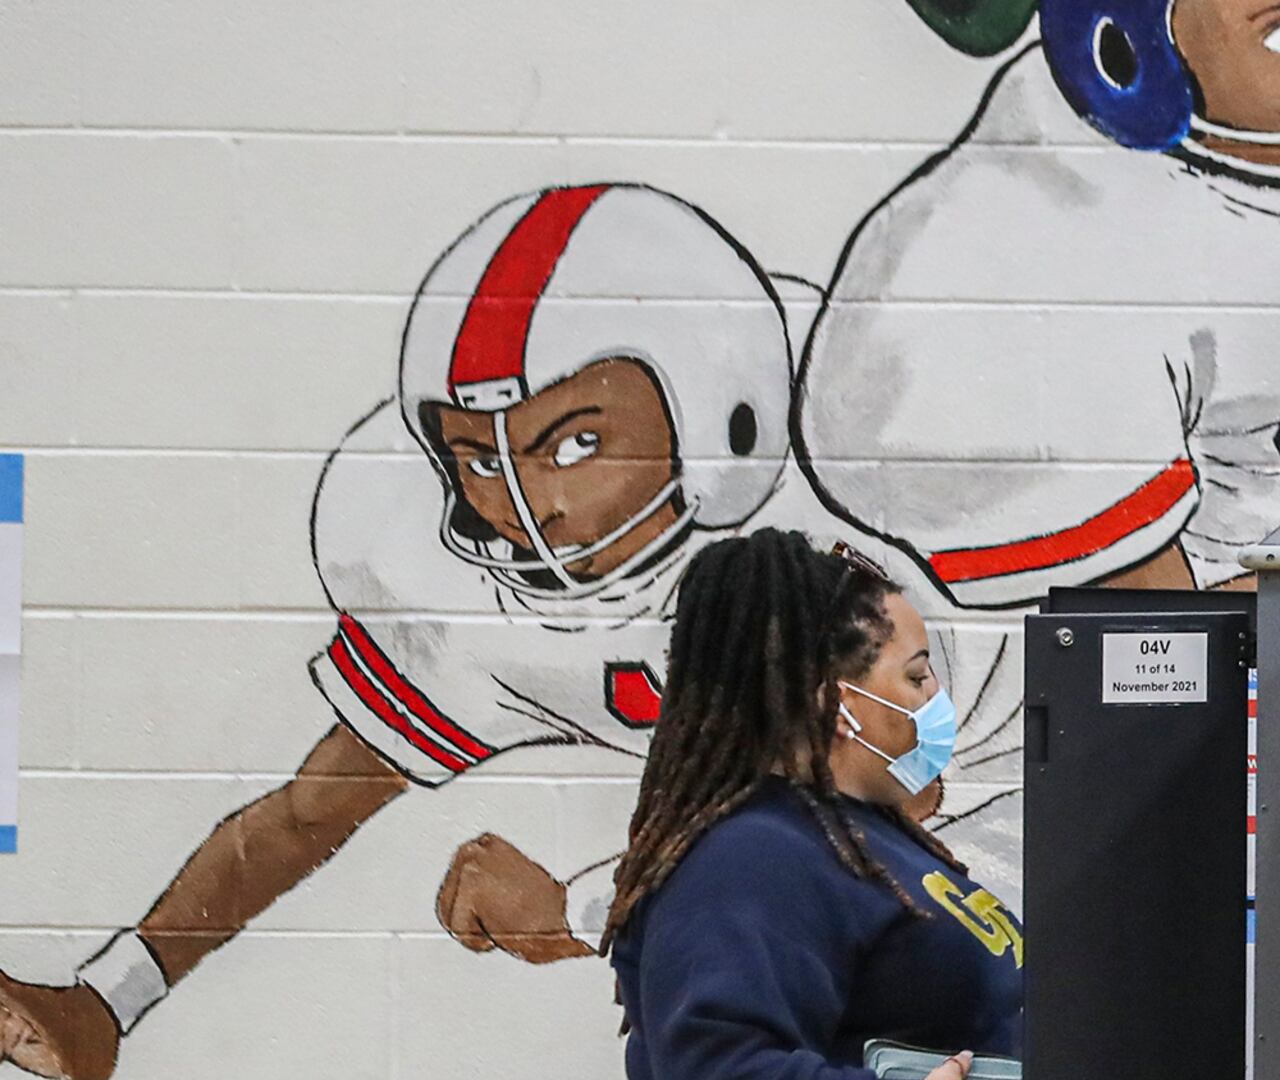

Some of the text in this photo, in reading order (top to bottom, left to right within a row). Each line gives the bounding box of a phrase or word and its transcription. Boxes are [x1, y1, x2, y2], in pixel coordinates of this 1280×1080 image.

[1140, 640, 1170, 655] 04V
[1136, 664, 1175, 674] 11 of 14
[1113, 681, 1197, 692] November 2021
